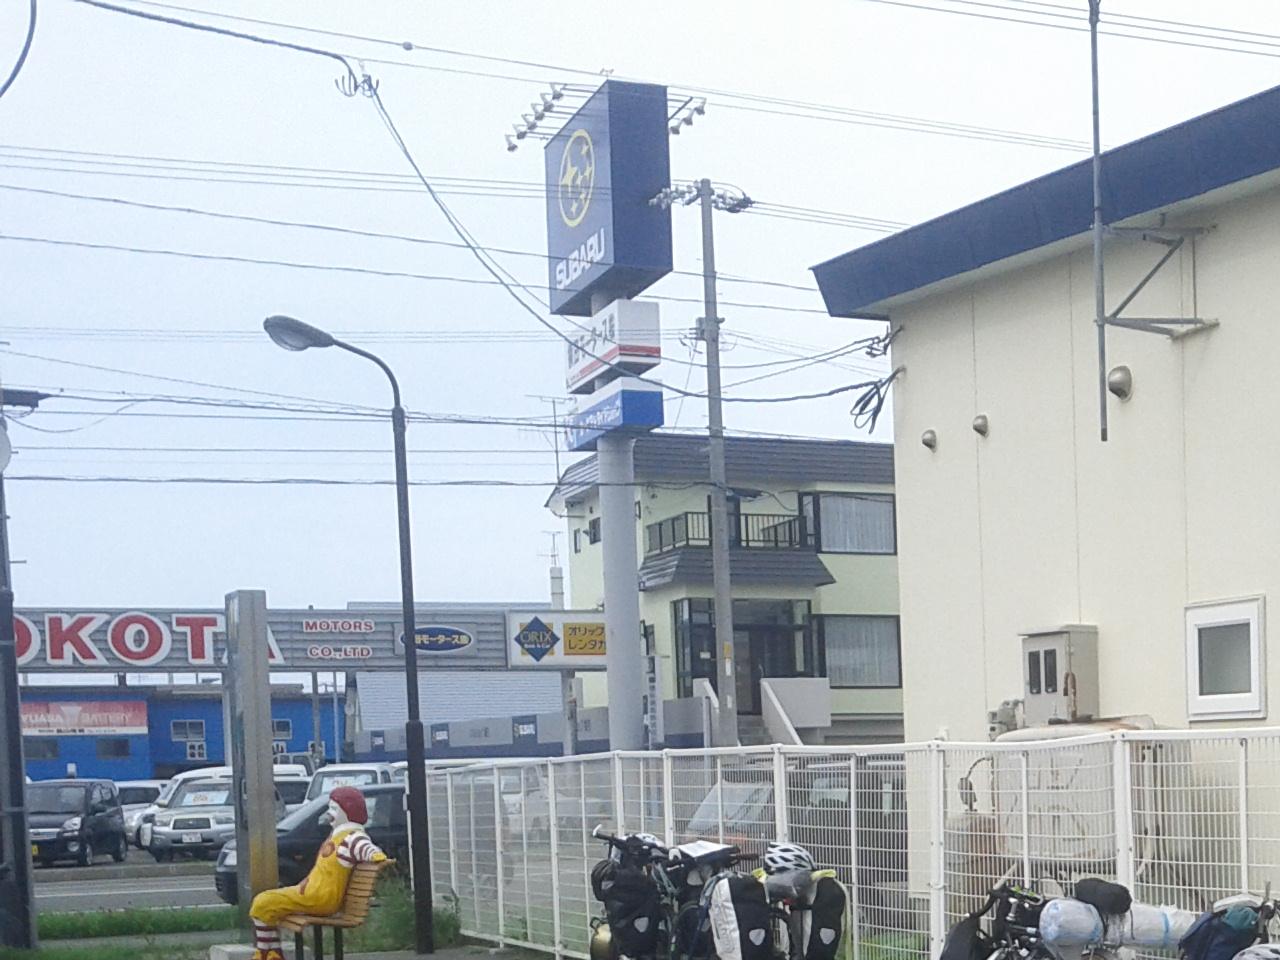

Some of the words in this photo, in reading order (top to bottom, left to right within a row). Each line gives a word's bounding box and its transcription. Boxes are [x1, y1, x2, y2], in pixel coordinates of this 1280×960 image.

[556, 227, 605, 290] SUBARU
[303, 620, 375, 633] MOTORS
[520, 631, 553, 643] ORIX
